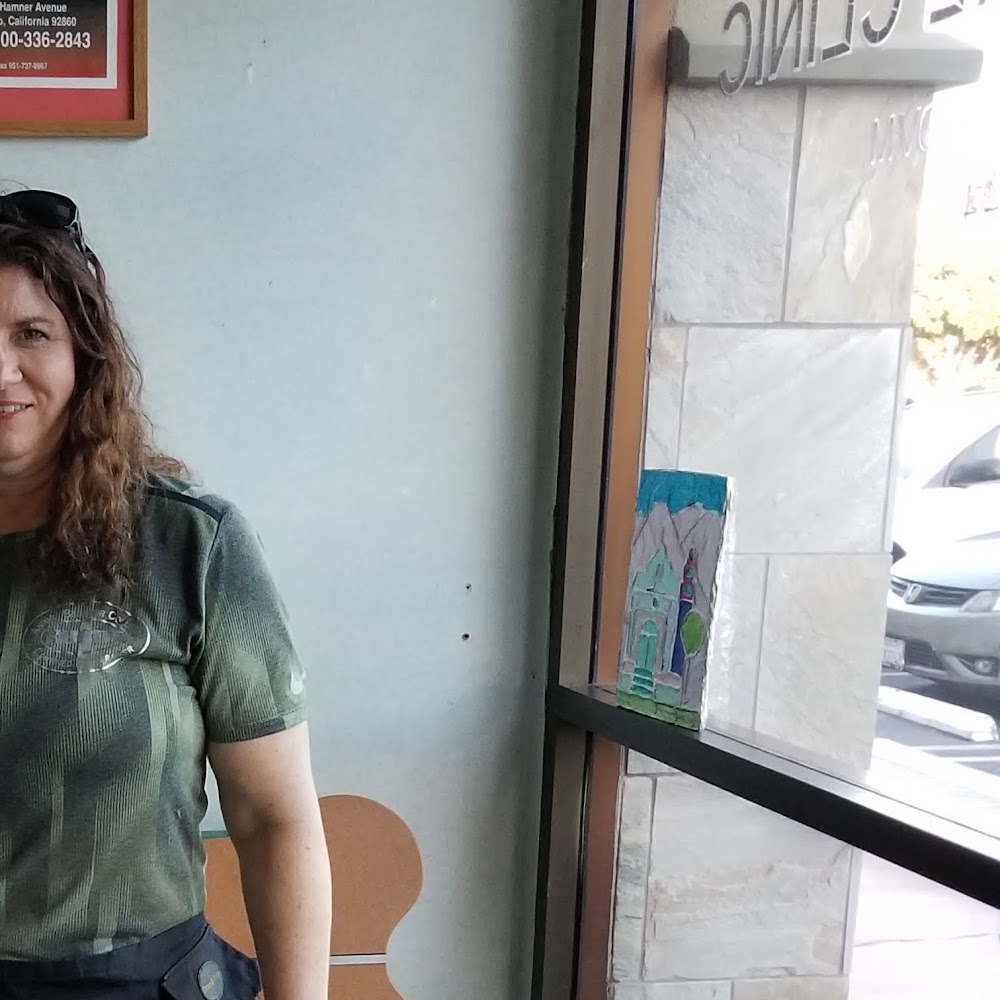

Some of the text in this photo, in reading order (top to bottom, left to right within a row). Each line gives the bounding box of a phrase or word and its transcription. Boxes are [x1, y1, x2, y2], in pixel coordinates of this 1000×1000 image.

[0, 2, 33, 12] Hamner
[35, 2, 67, 12] Avenue
[8, 16, 49, 26] California
[51, 17, 77, 26] 92860
